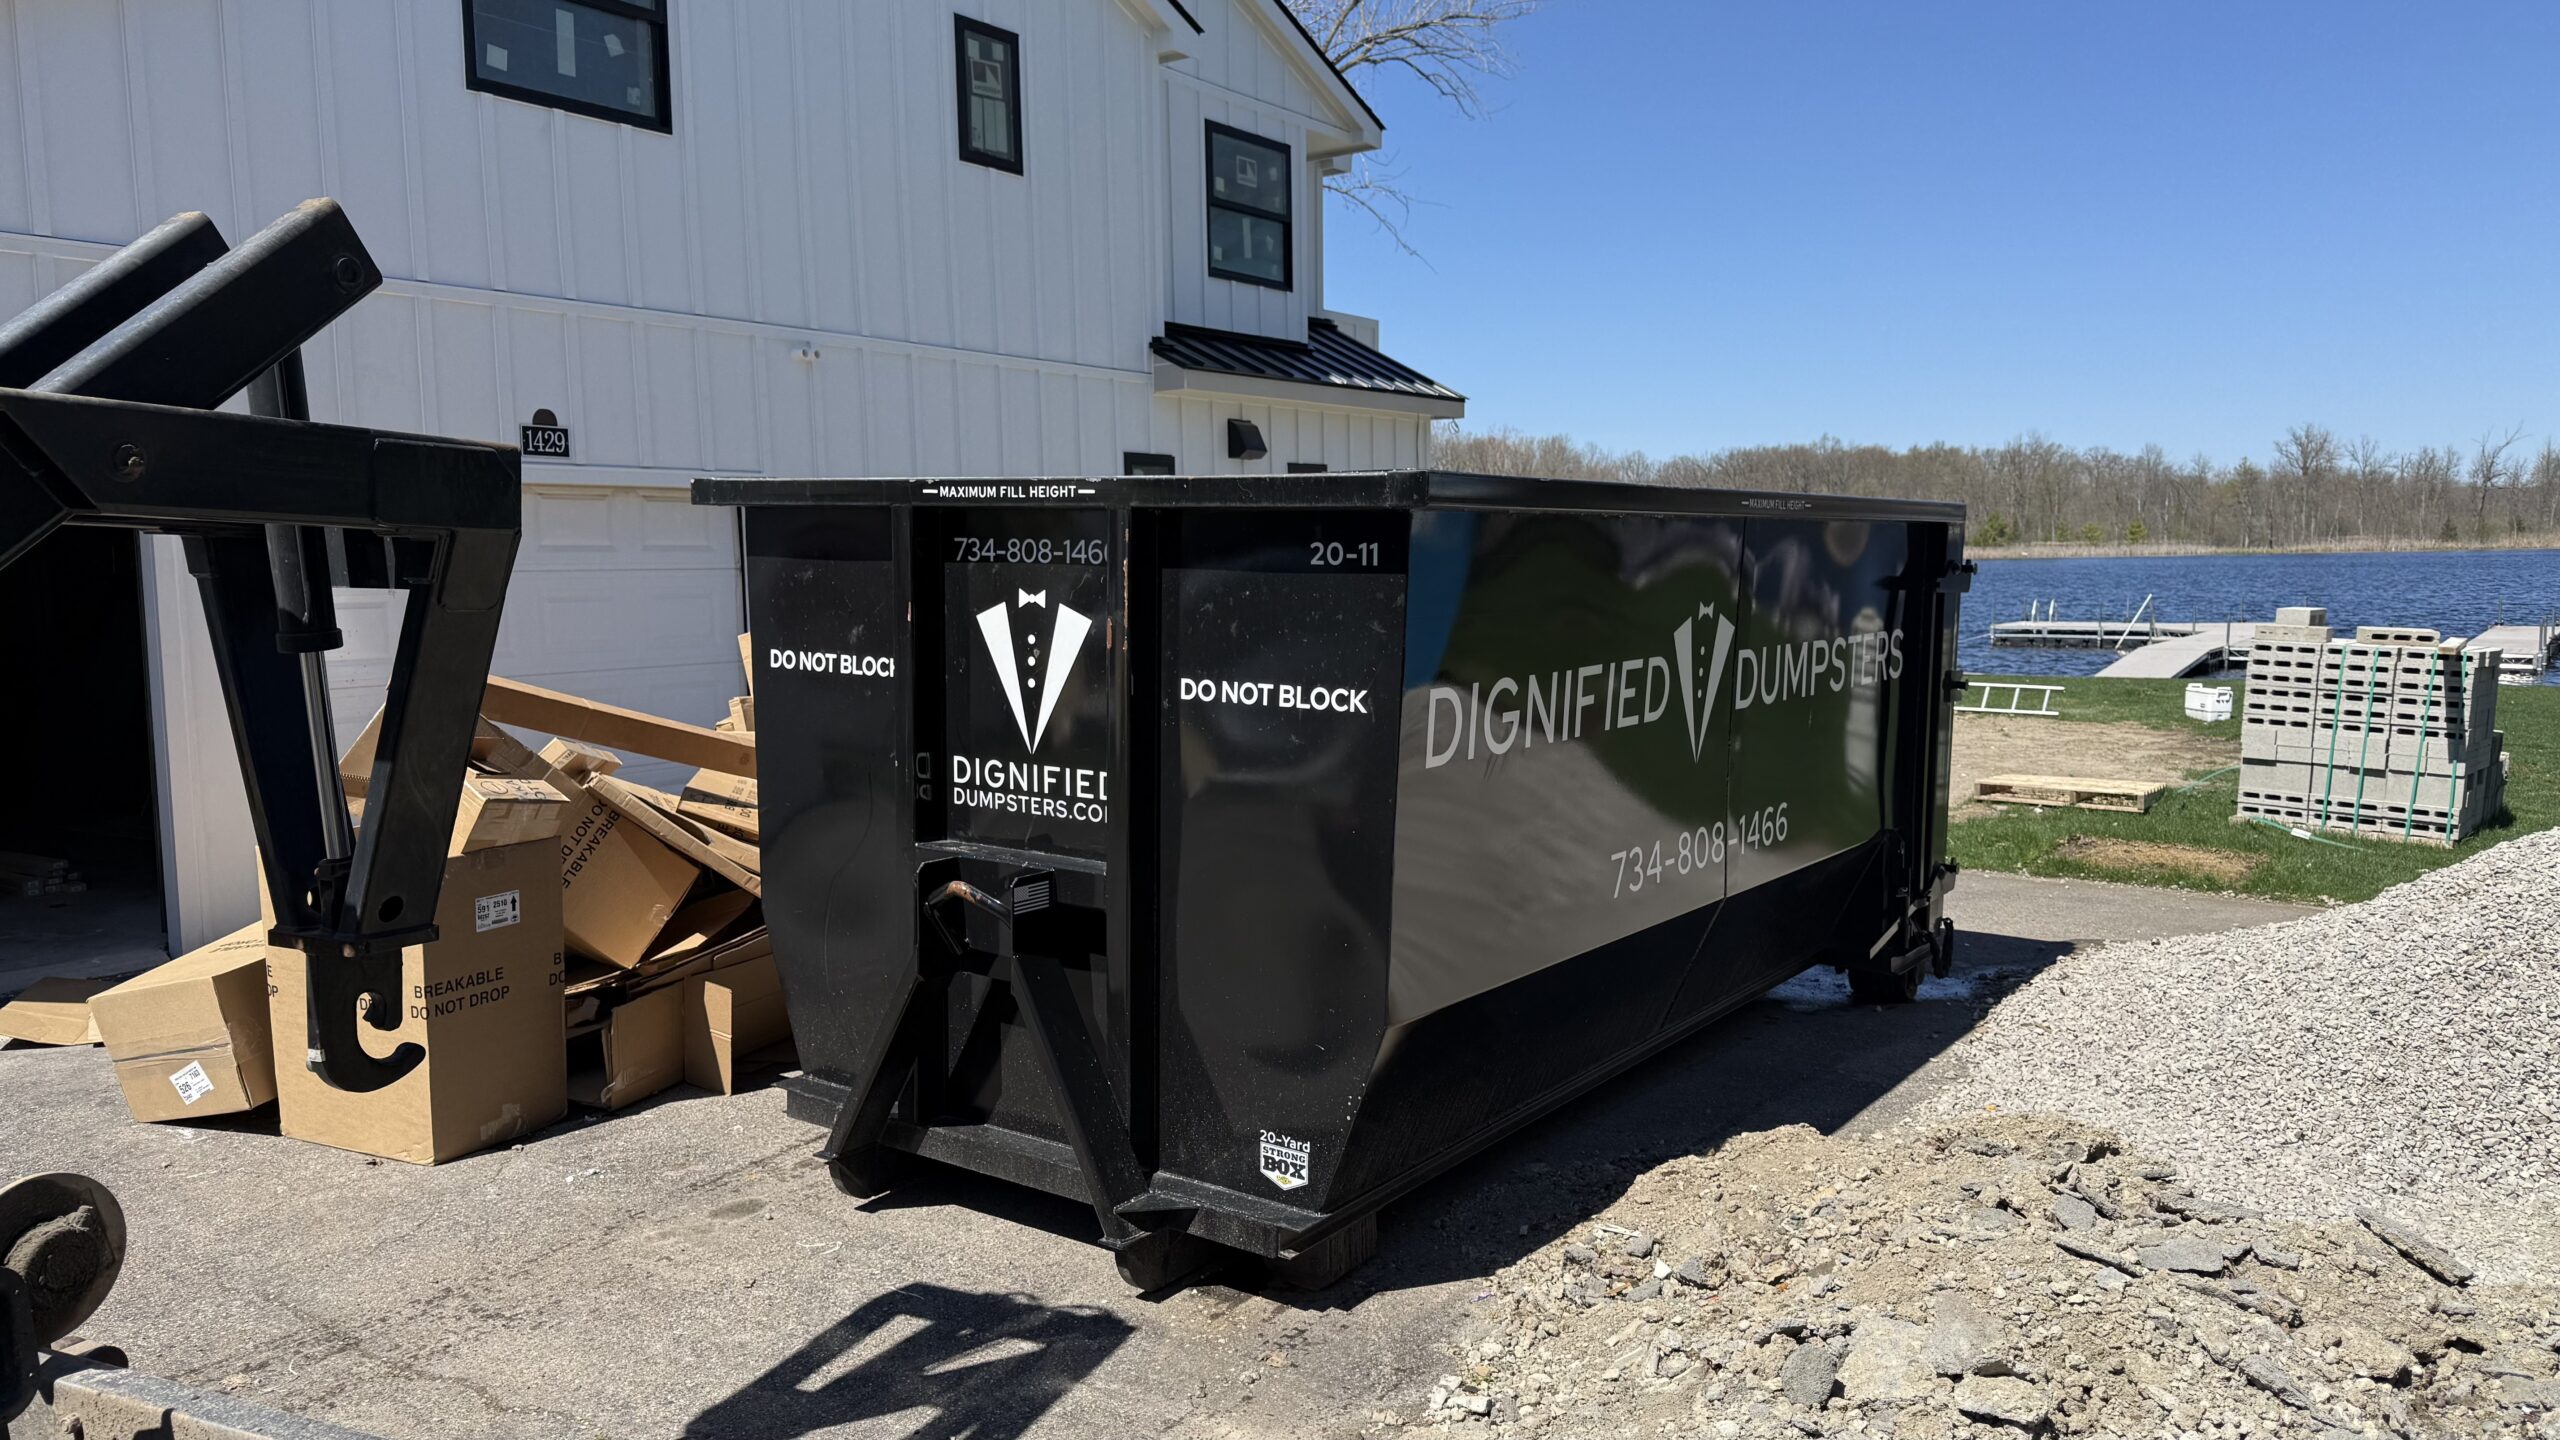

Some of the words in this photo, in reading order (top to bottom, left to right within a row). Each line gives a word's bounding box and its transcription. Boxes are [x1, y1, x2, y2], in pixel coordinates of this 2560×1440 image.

[526, 429, 566, 453] 1429
[939, 485, 997, 498] MAXIMUM
[1000, 486, 1026, 498] FILL
[1029, 485, 1077, 498] HEIGHT
[1749, 498, 1776, 509] MAXIMUM
[954, 537, 1108, 565] 734-808-146
[1310, 541, 1378, 566] 20-11
[770, 648, 796, 670] DO
[800, 650, 837, 673] NOT
[1180, 677, 1216, 702] DO
[1221, 680, 1274, 706] NOT
[1279, 684, 1368, 714] BLOCK
[1425, 655, 1671, 769] DIGNIFIED
[1735, 628, 1904, 710] DUMPSTERS
[953, 787, 1108, 824] DUMPSTERS.CO
[570, 816, 595, 846] NOT
[1610, 801, 1788, 899] 734-808-1466
[414, 967, 504, 999] BREAKABLE
[411, 1005, 429, 1020] DO
[434, 997, 465, 1017] NOT
[469, 985, 510, 1007] DROP
[178, 1081, 192, 1094] 526
[1260, 1129, 1310, 1153] 20-Yard
[1263, 1146, 1305, 1163] STRONG
[1263, 1154, 1306, 1180] BOX
